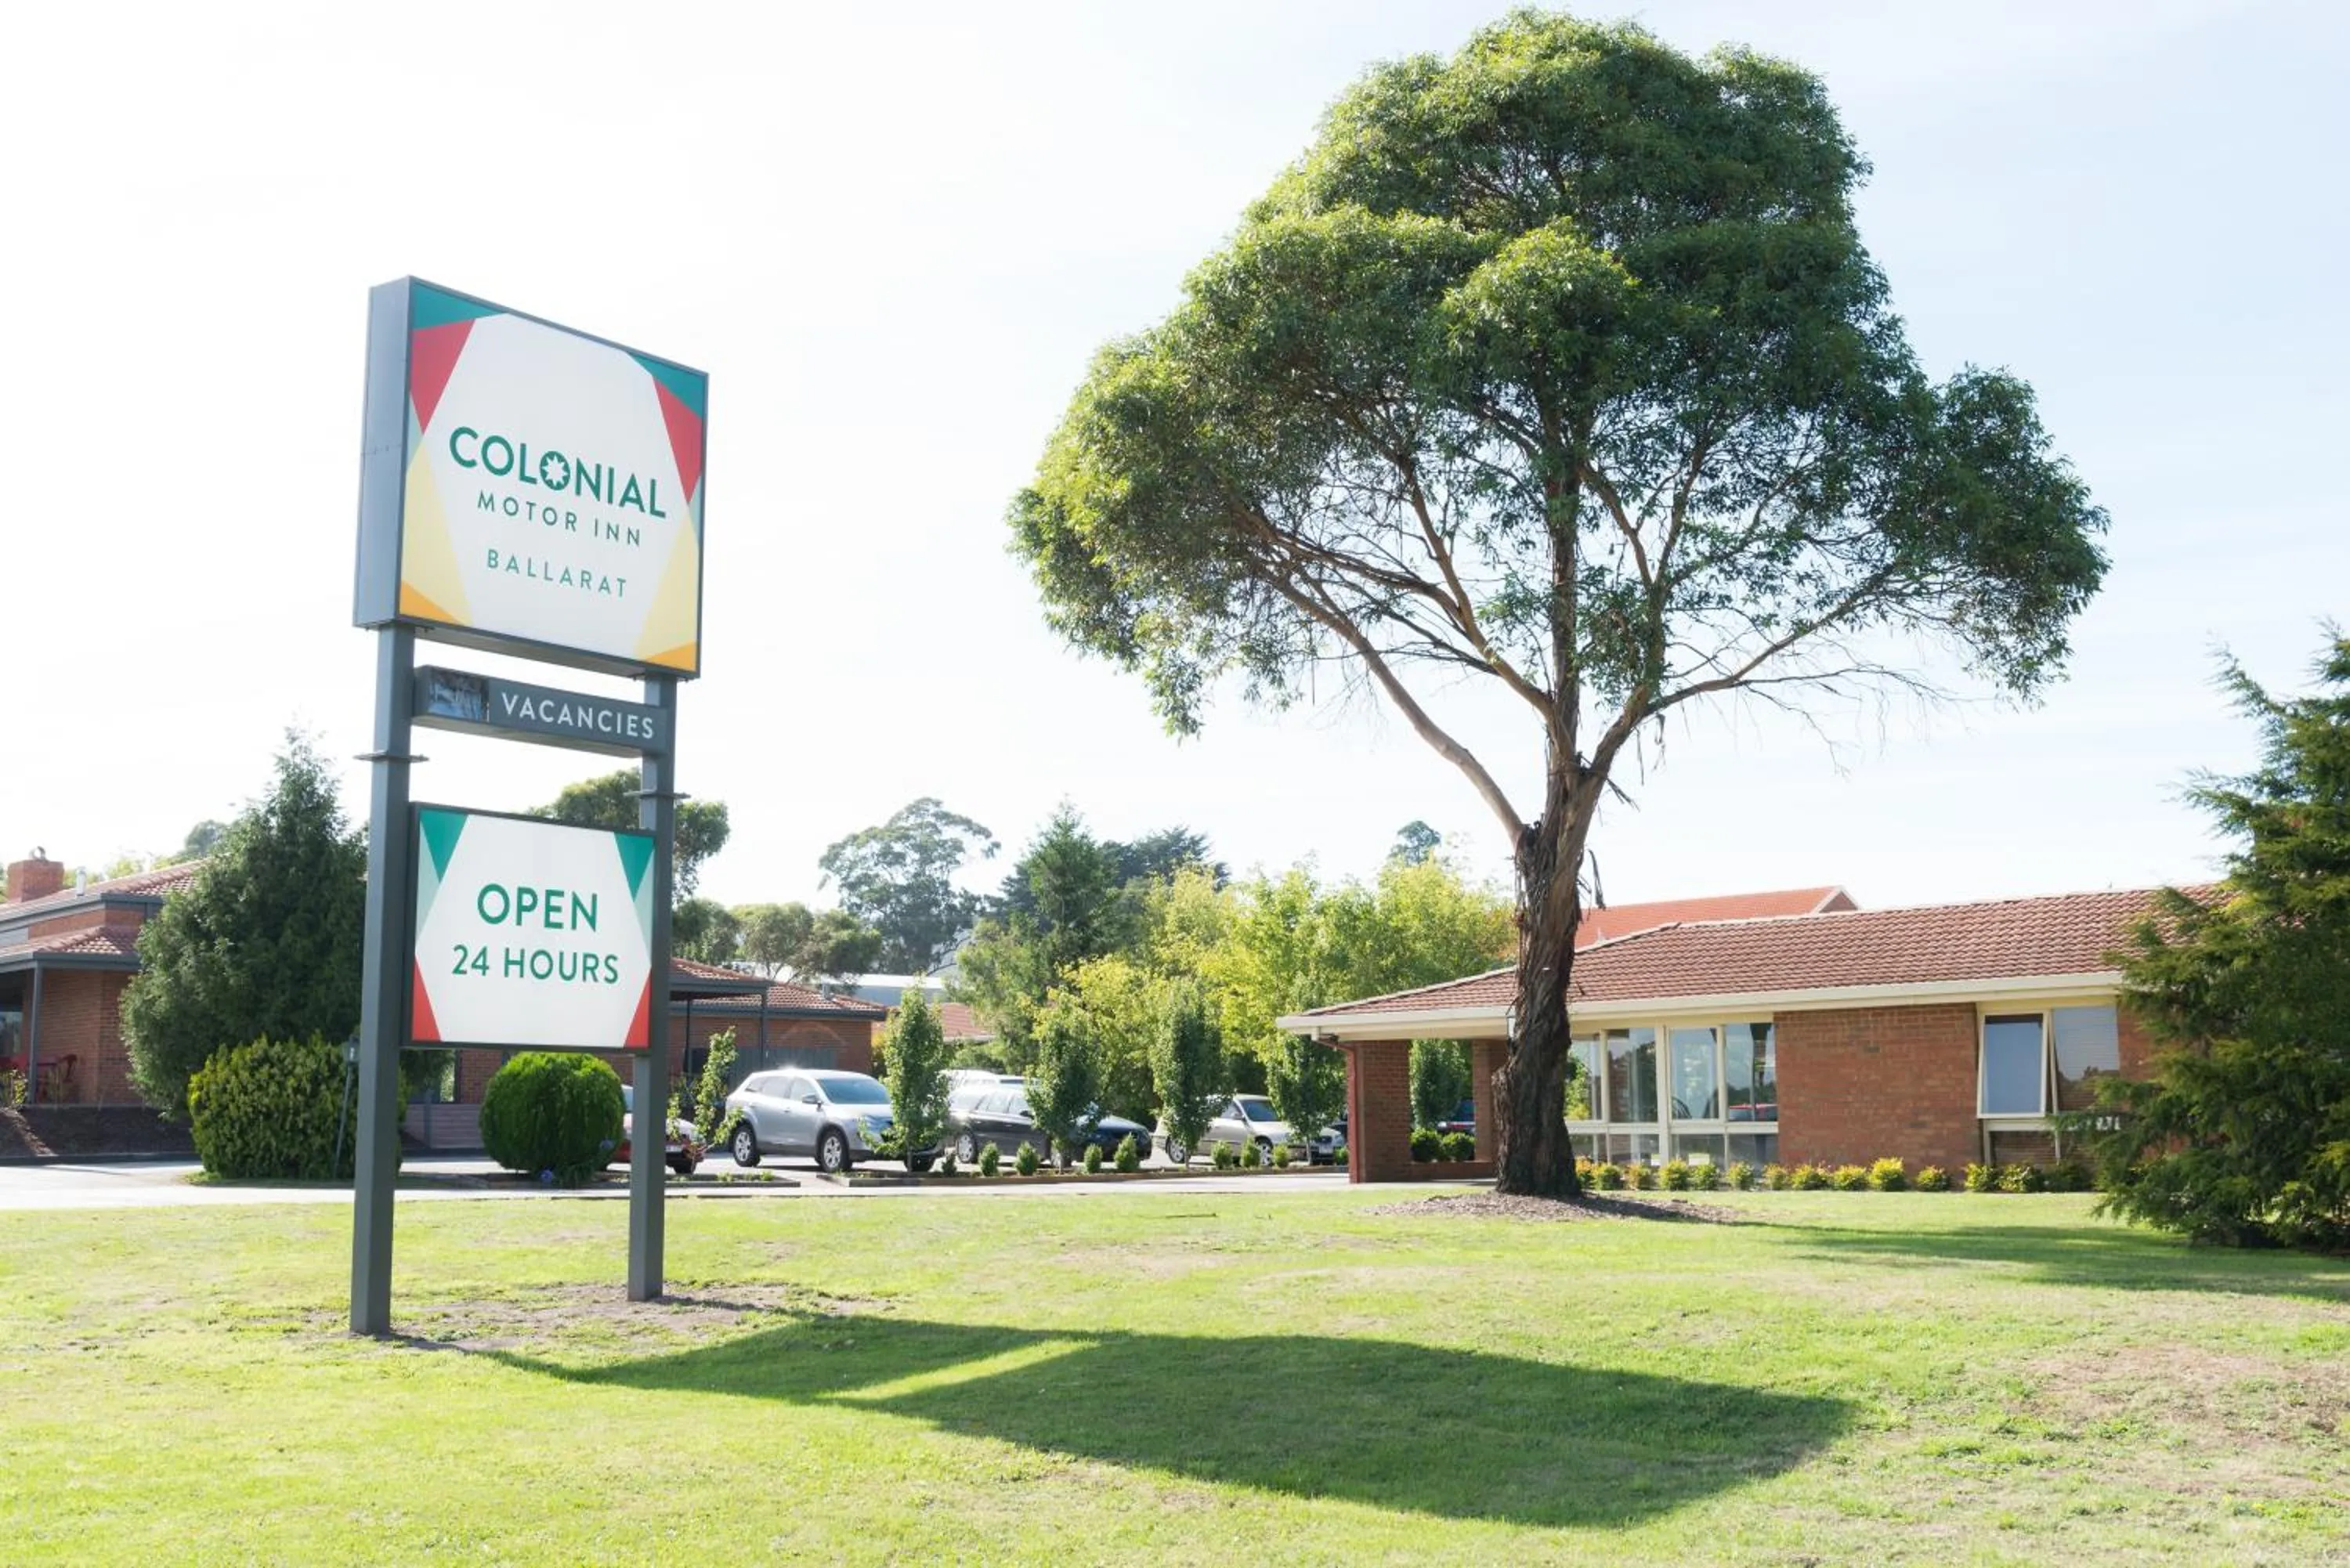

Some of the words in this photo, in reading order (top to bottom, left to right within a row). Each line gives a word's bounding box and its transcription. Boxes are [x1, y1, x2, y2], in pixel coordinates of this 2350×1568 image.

[449, 425, 667, 519] COLONIAL
[477, 490, 577, 532] MOTOR
[594, 518, 640, 546] INN
[486, 548, 627, 598] BALLARAT
[501, 692, 654, 739] VACANCIES
[477, 883, 598, 933] OPEN
[451, 944, 490, 977] 24
[504, 947, 619, 985] HOURS
